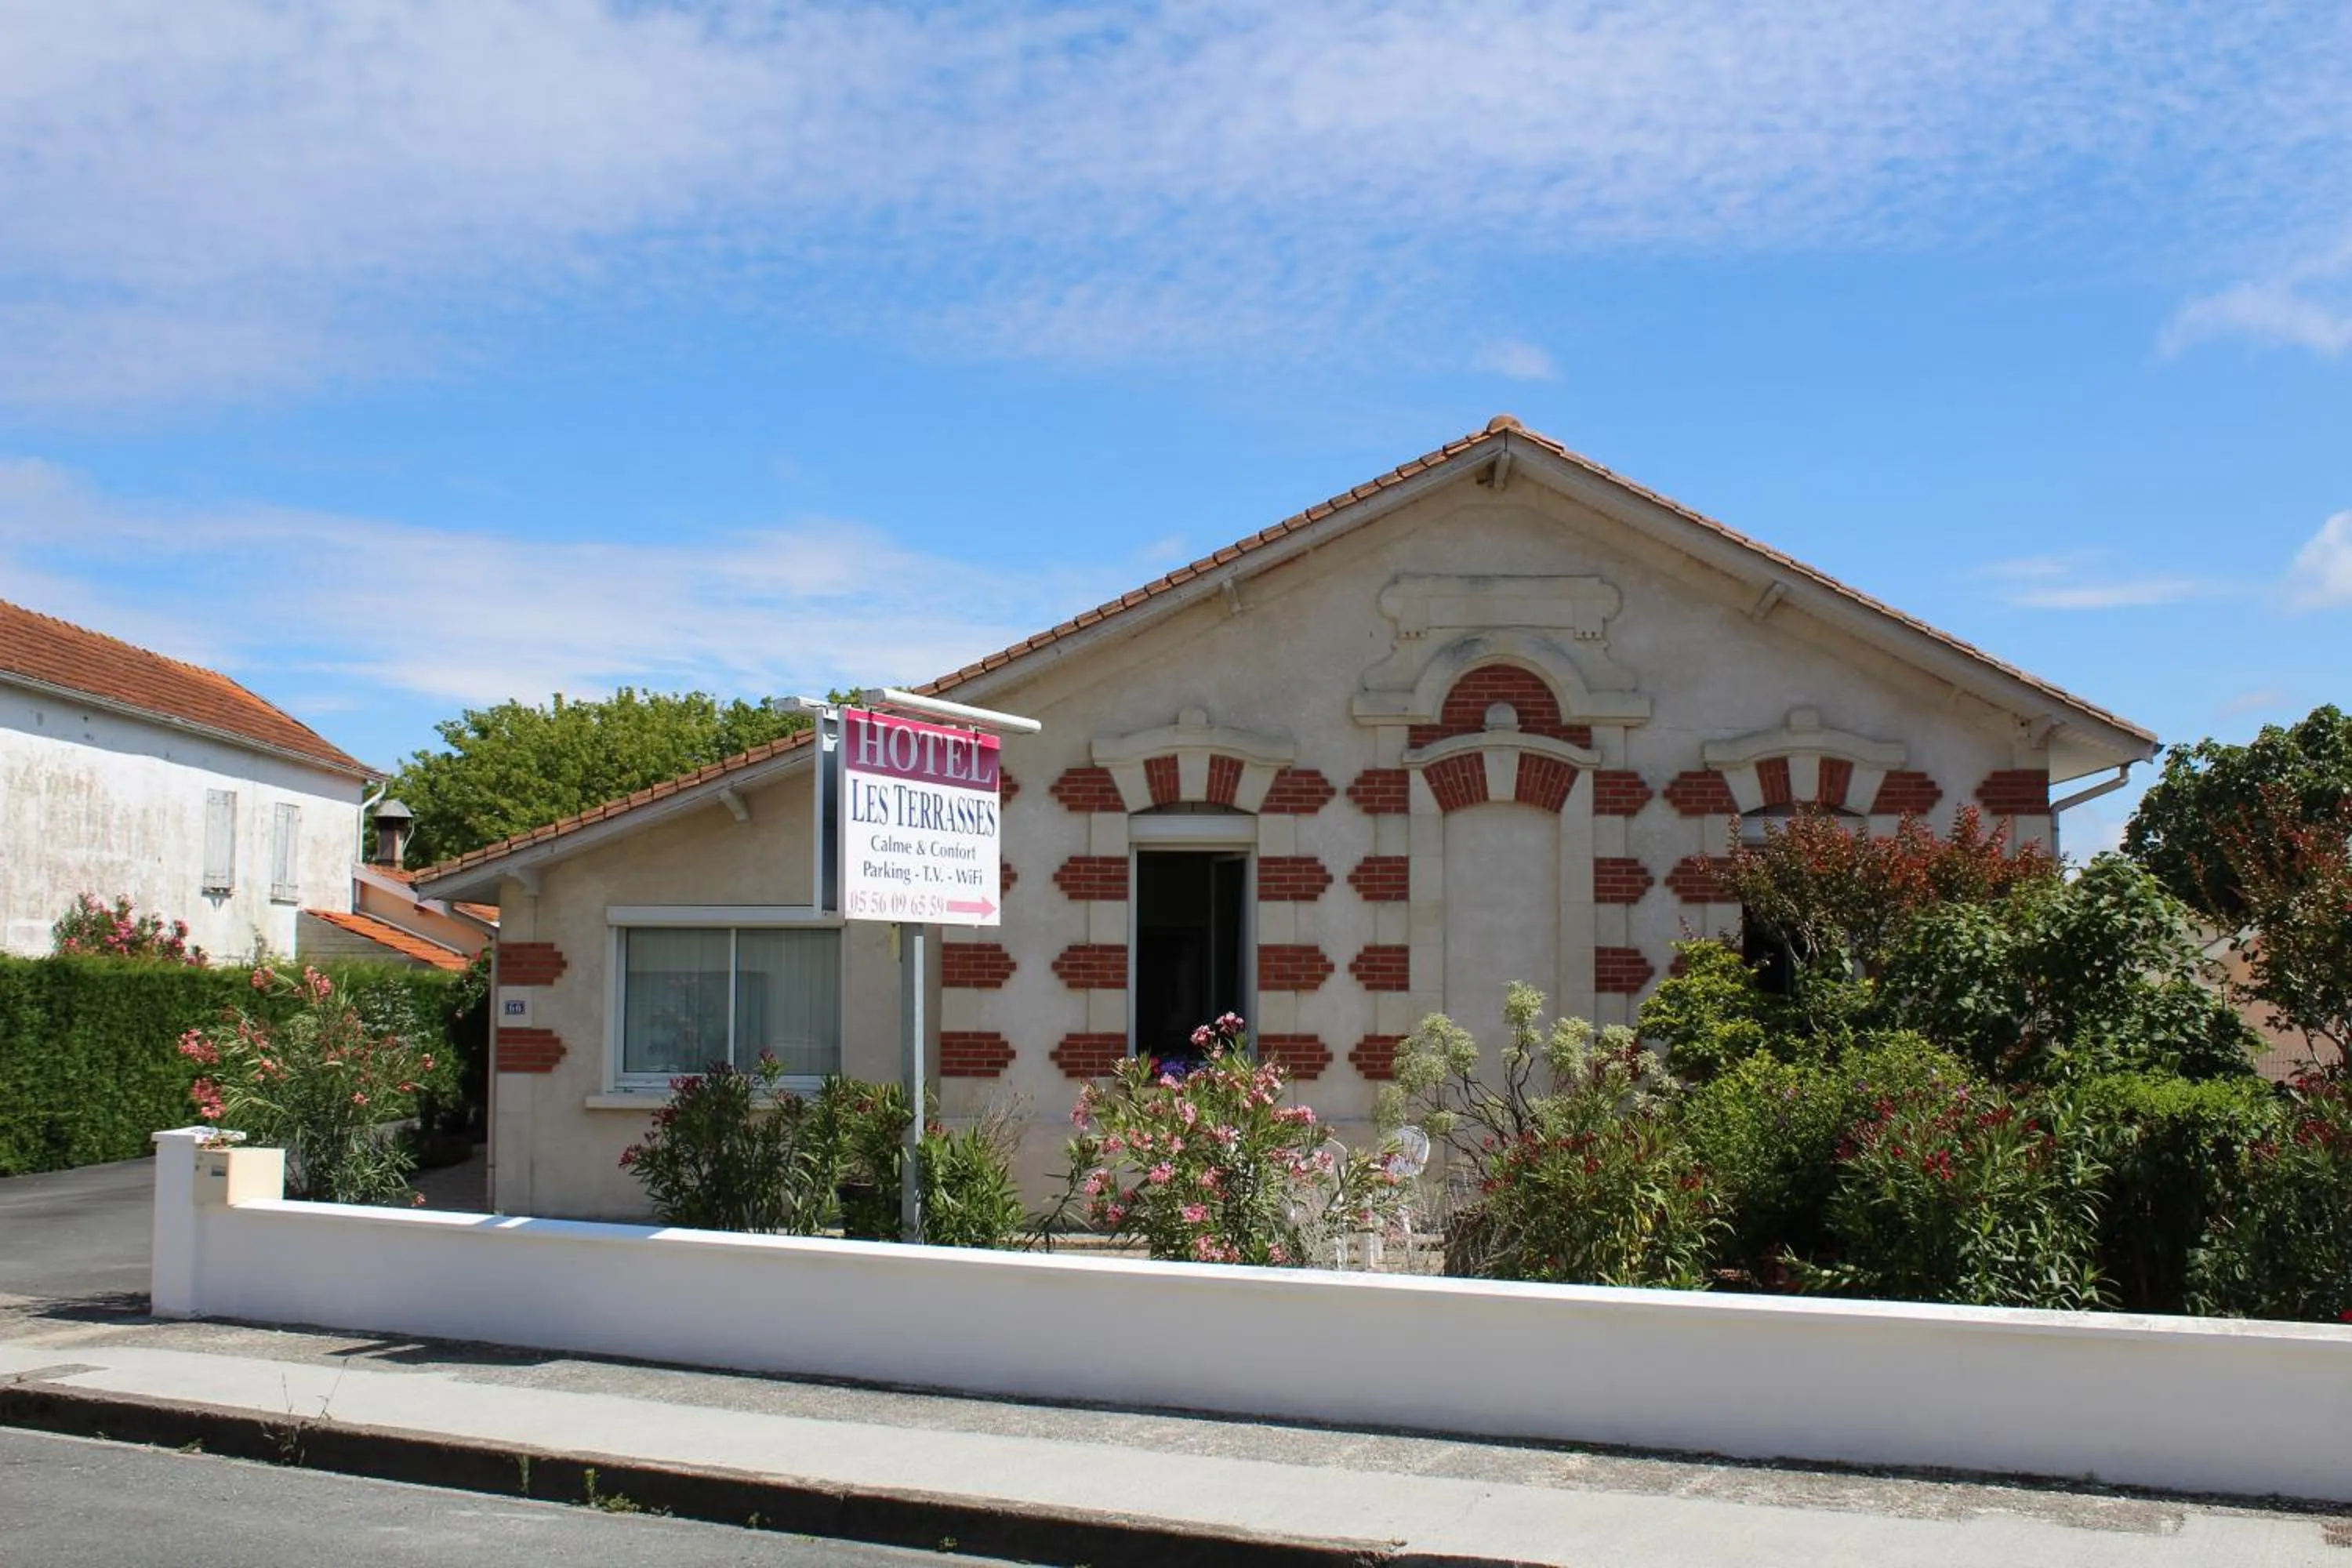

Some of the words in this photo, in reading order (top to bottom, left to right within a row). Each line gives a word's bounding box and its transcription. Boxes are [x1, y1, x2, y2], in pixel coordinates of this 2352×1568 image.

[856, 719, 992, 782] HOTEL
[852, 779, 888, 826] LES
[894, 784, 996, 837] TERRASSES
[871, 835, 913, 854] Calme
[916, 840, 926, 855] &
[931, 841, 977, 860] Confort
[863, 861, 911, 885] Parking
[924, 866, 944, 883] T.V.
[956, 869, 982, 886] WiFi
[850, 891, 867, 913] 05
